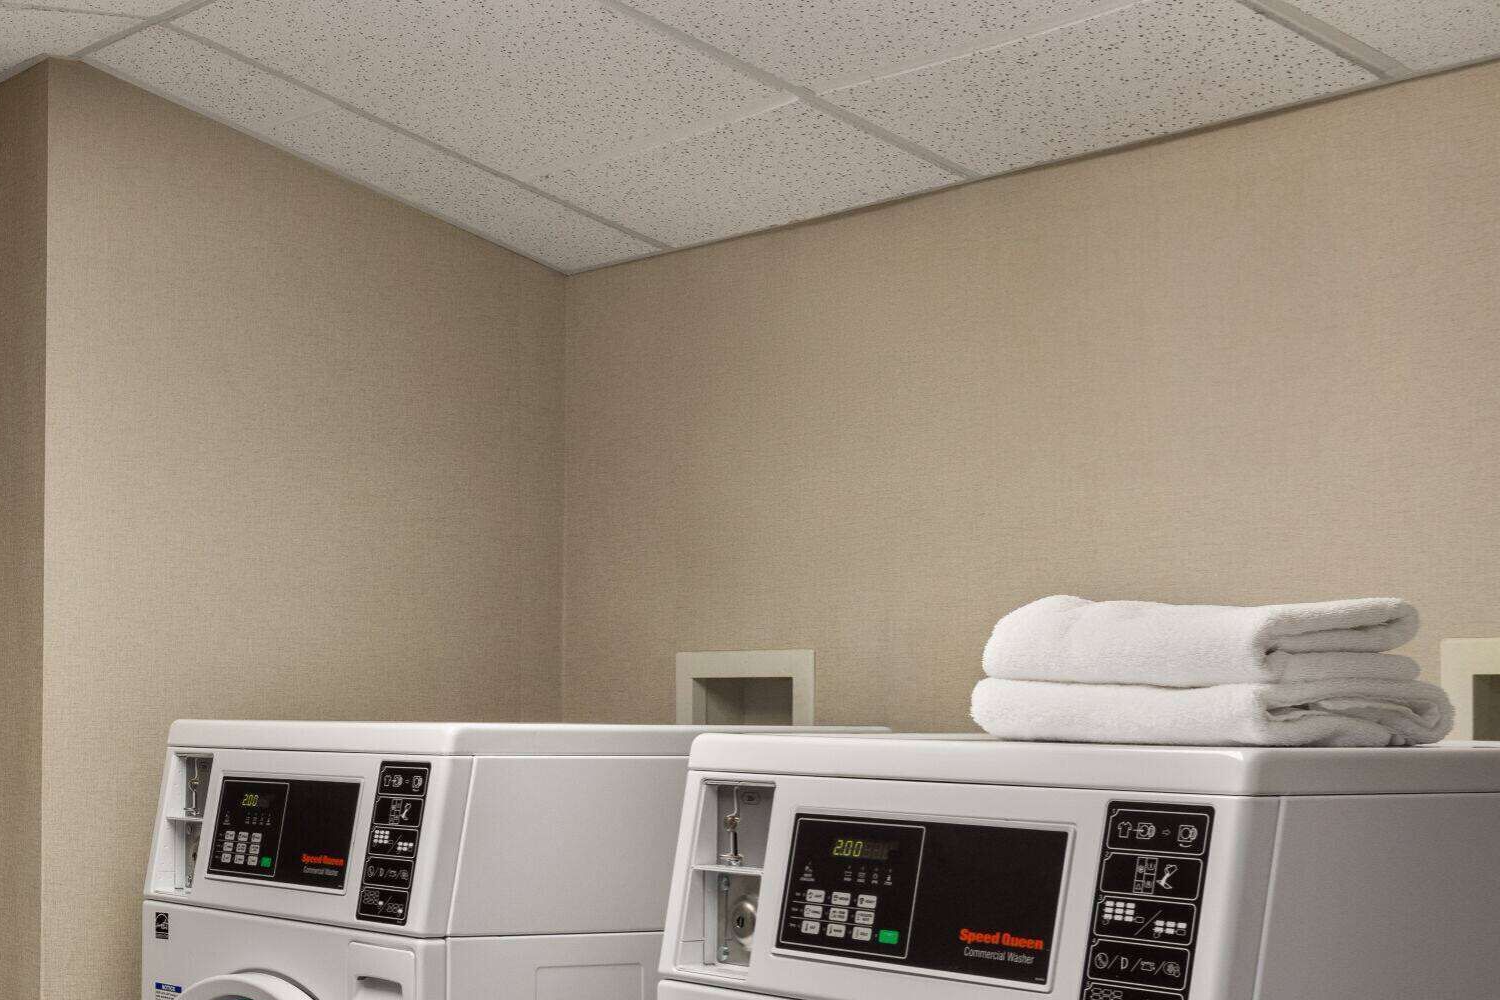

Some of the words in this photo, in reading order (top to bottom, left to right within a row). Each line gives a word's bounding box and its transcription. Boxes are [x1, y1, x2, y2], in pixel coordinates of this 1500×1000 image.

[960, 928, 1001, 944] Speed
[1002, 932, 1044, 950] Queen
[963, 946, 1006, 961] Commercial
[1007, 951, 1035, 965] Washer
